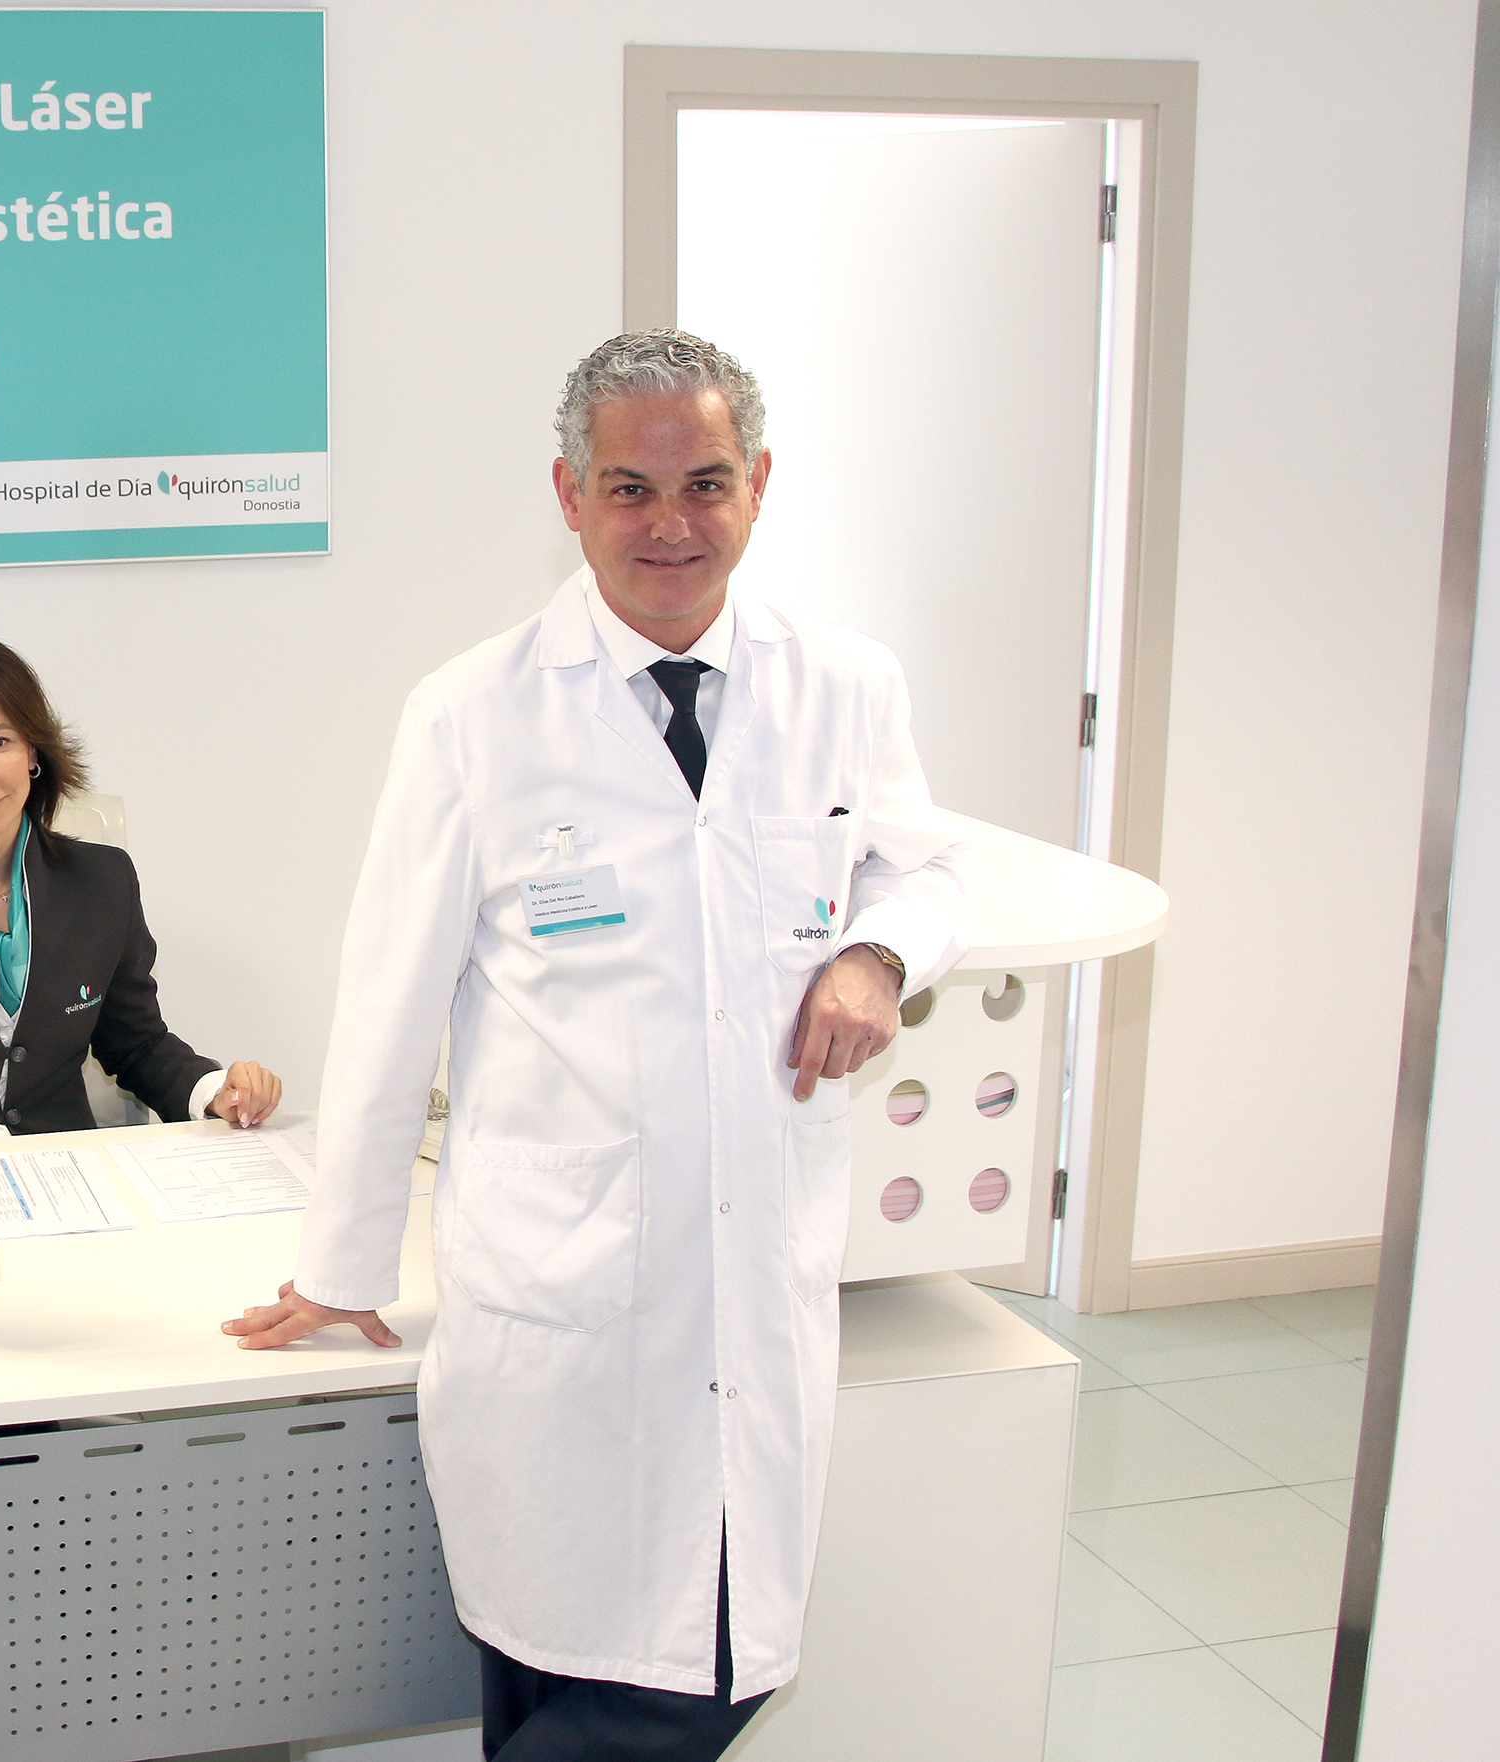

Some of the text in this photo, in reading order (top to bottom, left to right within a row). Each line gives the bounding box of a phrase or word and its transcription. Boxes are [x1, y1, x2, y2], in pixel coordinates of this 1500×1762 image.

[0, 80, 152, 131] Láser
[85, 480, 112, 498] de
[117, 476, 153, 497] Día
[178, 473, 301, 500] quirónsalud
[243, 499, 301, 512] Donostia
